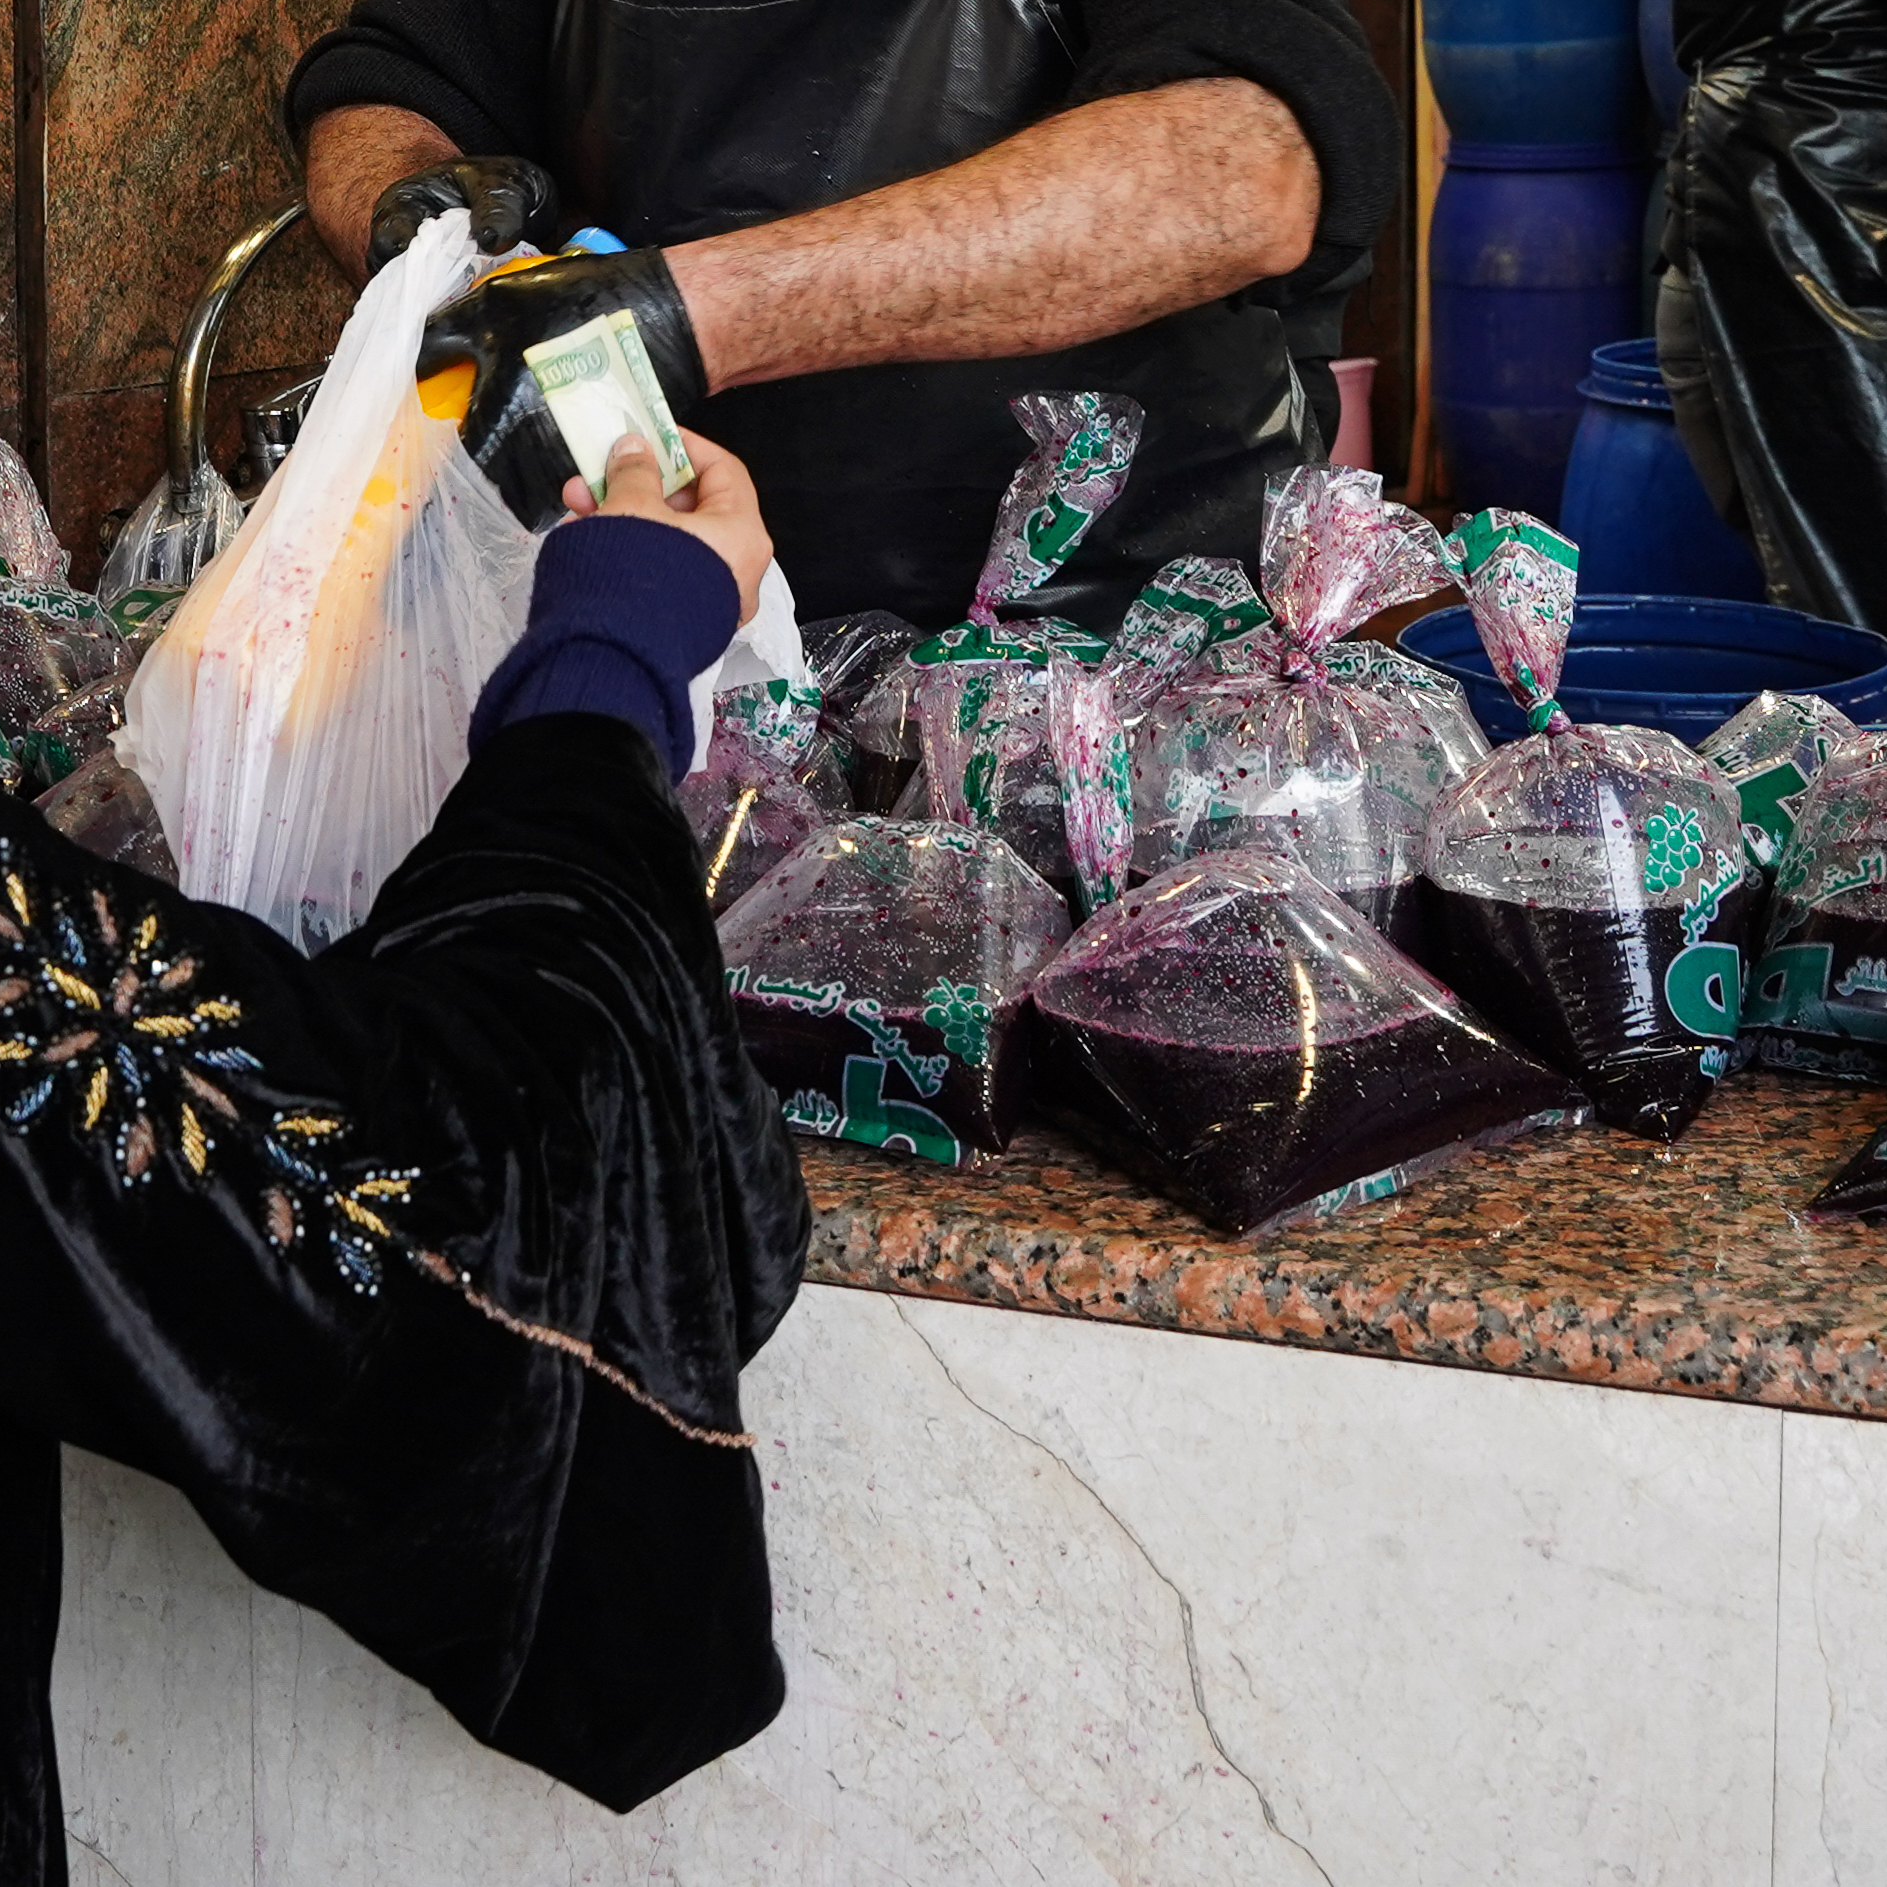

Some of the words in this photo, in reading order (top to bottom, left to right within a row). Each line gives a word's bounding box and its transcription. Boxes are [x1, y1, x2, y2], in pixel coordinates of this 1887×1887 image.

[539, 351, 602, 387] 10000
[753, 974, 846, 1018] زبيب
[845, 998, 950, 1099] شربت
